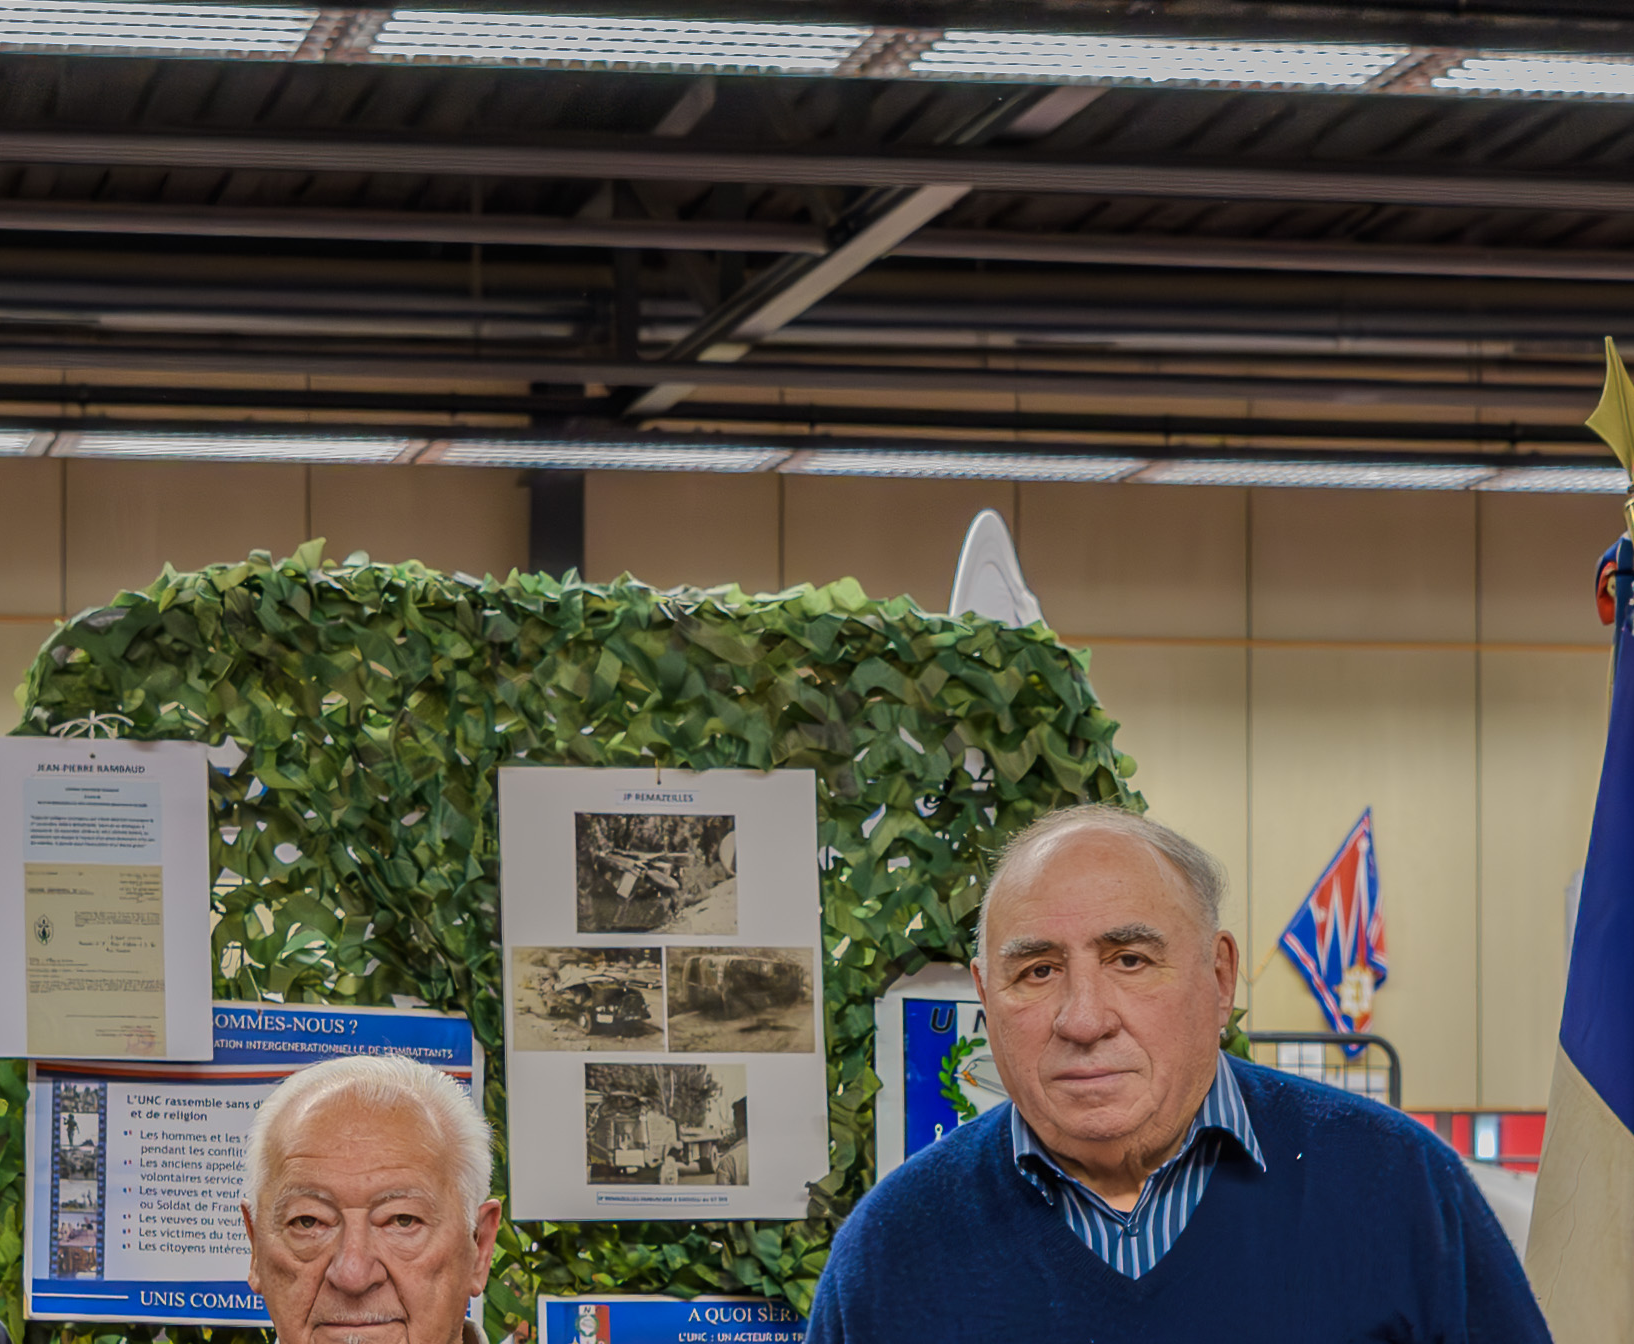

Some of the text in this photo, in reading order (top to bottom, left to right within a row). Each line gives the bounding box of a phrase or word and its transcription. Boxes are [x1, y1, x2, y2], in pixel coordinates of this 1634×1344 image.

[37, 763, 146, 774] JEAN-PIERRE RAMBAUD
[126, 1094, 250, 1109] L'UNC rassemble sans
[131, 1110, 208, 1122] et de religion
[140, 1130, 240, 1143] Les hommes et les
[141, 1145, 186, 1155] pendant
[189, 1145, 205, 1156] les
[140, 1158, 158, 1168] Les
[161, 1159, 203, 1169] anciens
[140, 1172, 244, 1185] volontaires service
[139, 1186, 158, 1196] Les
[161, 1188, 198, 1197] veuves
[201, 1189, 212, 1198] et
[140, 1201, 153, 1210] ou
[157, 1200, 191, 1211] Soldat
[194, 1201, 208, 1211] de
[139, 1214, 157, 1224] Les
[160, 1216, 198, 1225] veuves
[201, 1217, 214, 1226] ou
[139, 1227, 157, 1237] Les
[160, 1228, 206, 1239] victimes
[209, 1230, 223, 1240] du
[138, 1241, 156, 1251] Les
[160, 1243, 206, 1254] citoyens
[140, 1290, 264, 1310] UNIS COMME
[688, 1307, 702, 1322] A
[705, 1307, 752, 1325] QUOI
[734, 1332, 772, 1342] ACTEUR
[775, 1332, 790, 1342] DU
